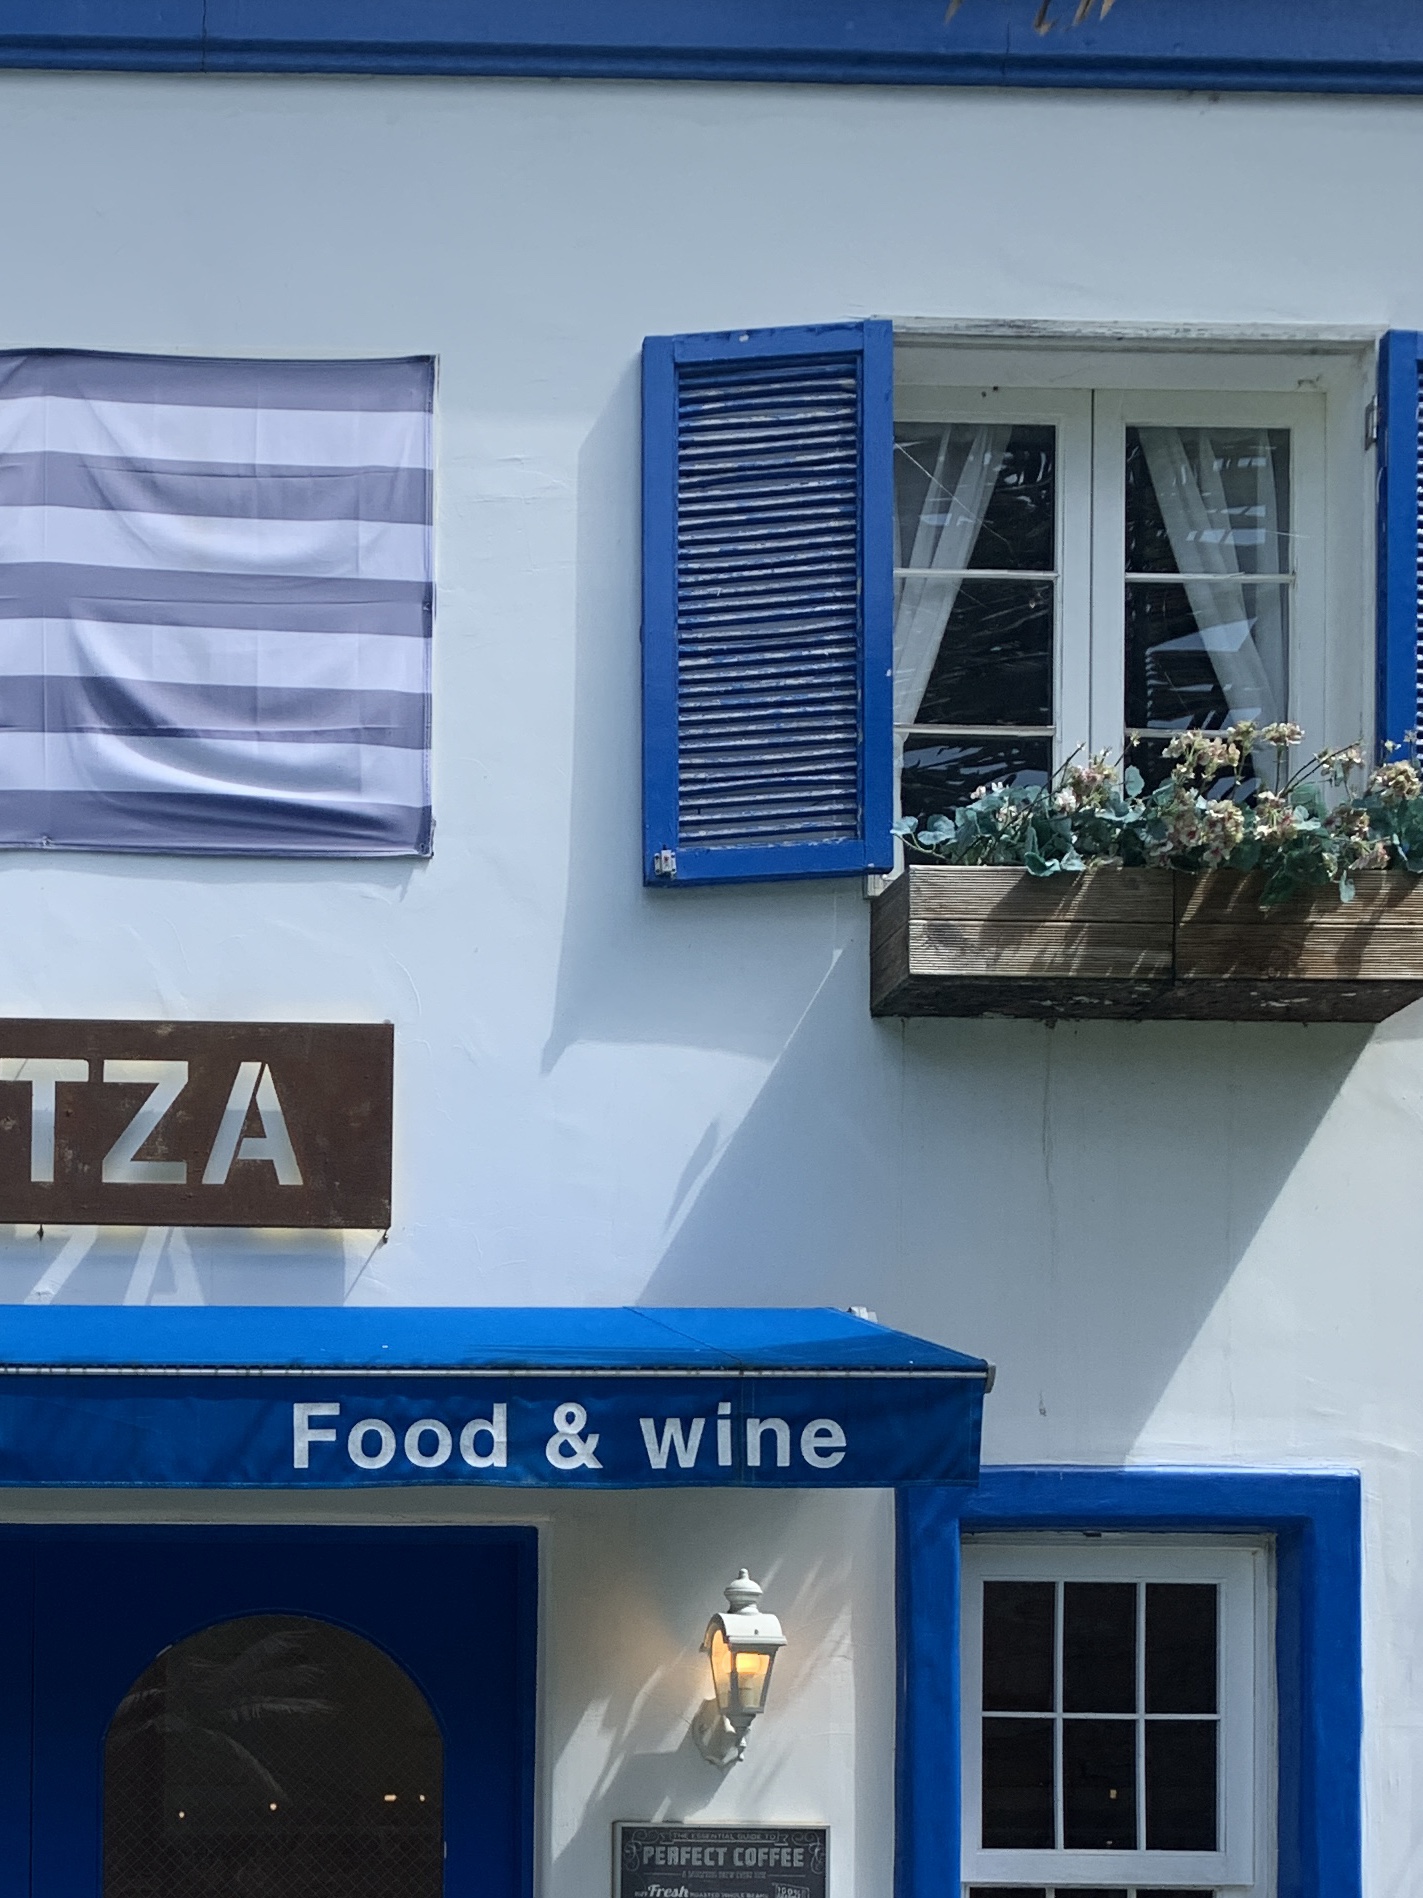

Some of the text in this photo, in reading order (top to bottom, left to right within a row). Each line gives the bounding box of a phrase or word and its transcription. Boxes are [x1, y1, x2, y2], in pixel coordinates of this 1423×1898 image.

[293, 1402, 847, 1469] Food & wine
[643, 1846, 804, 1867] PERFECT COFFEE
[648, 1884, 688, 1898] Fresh
